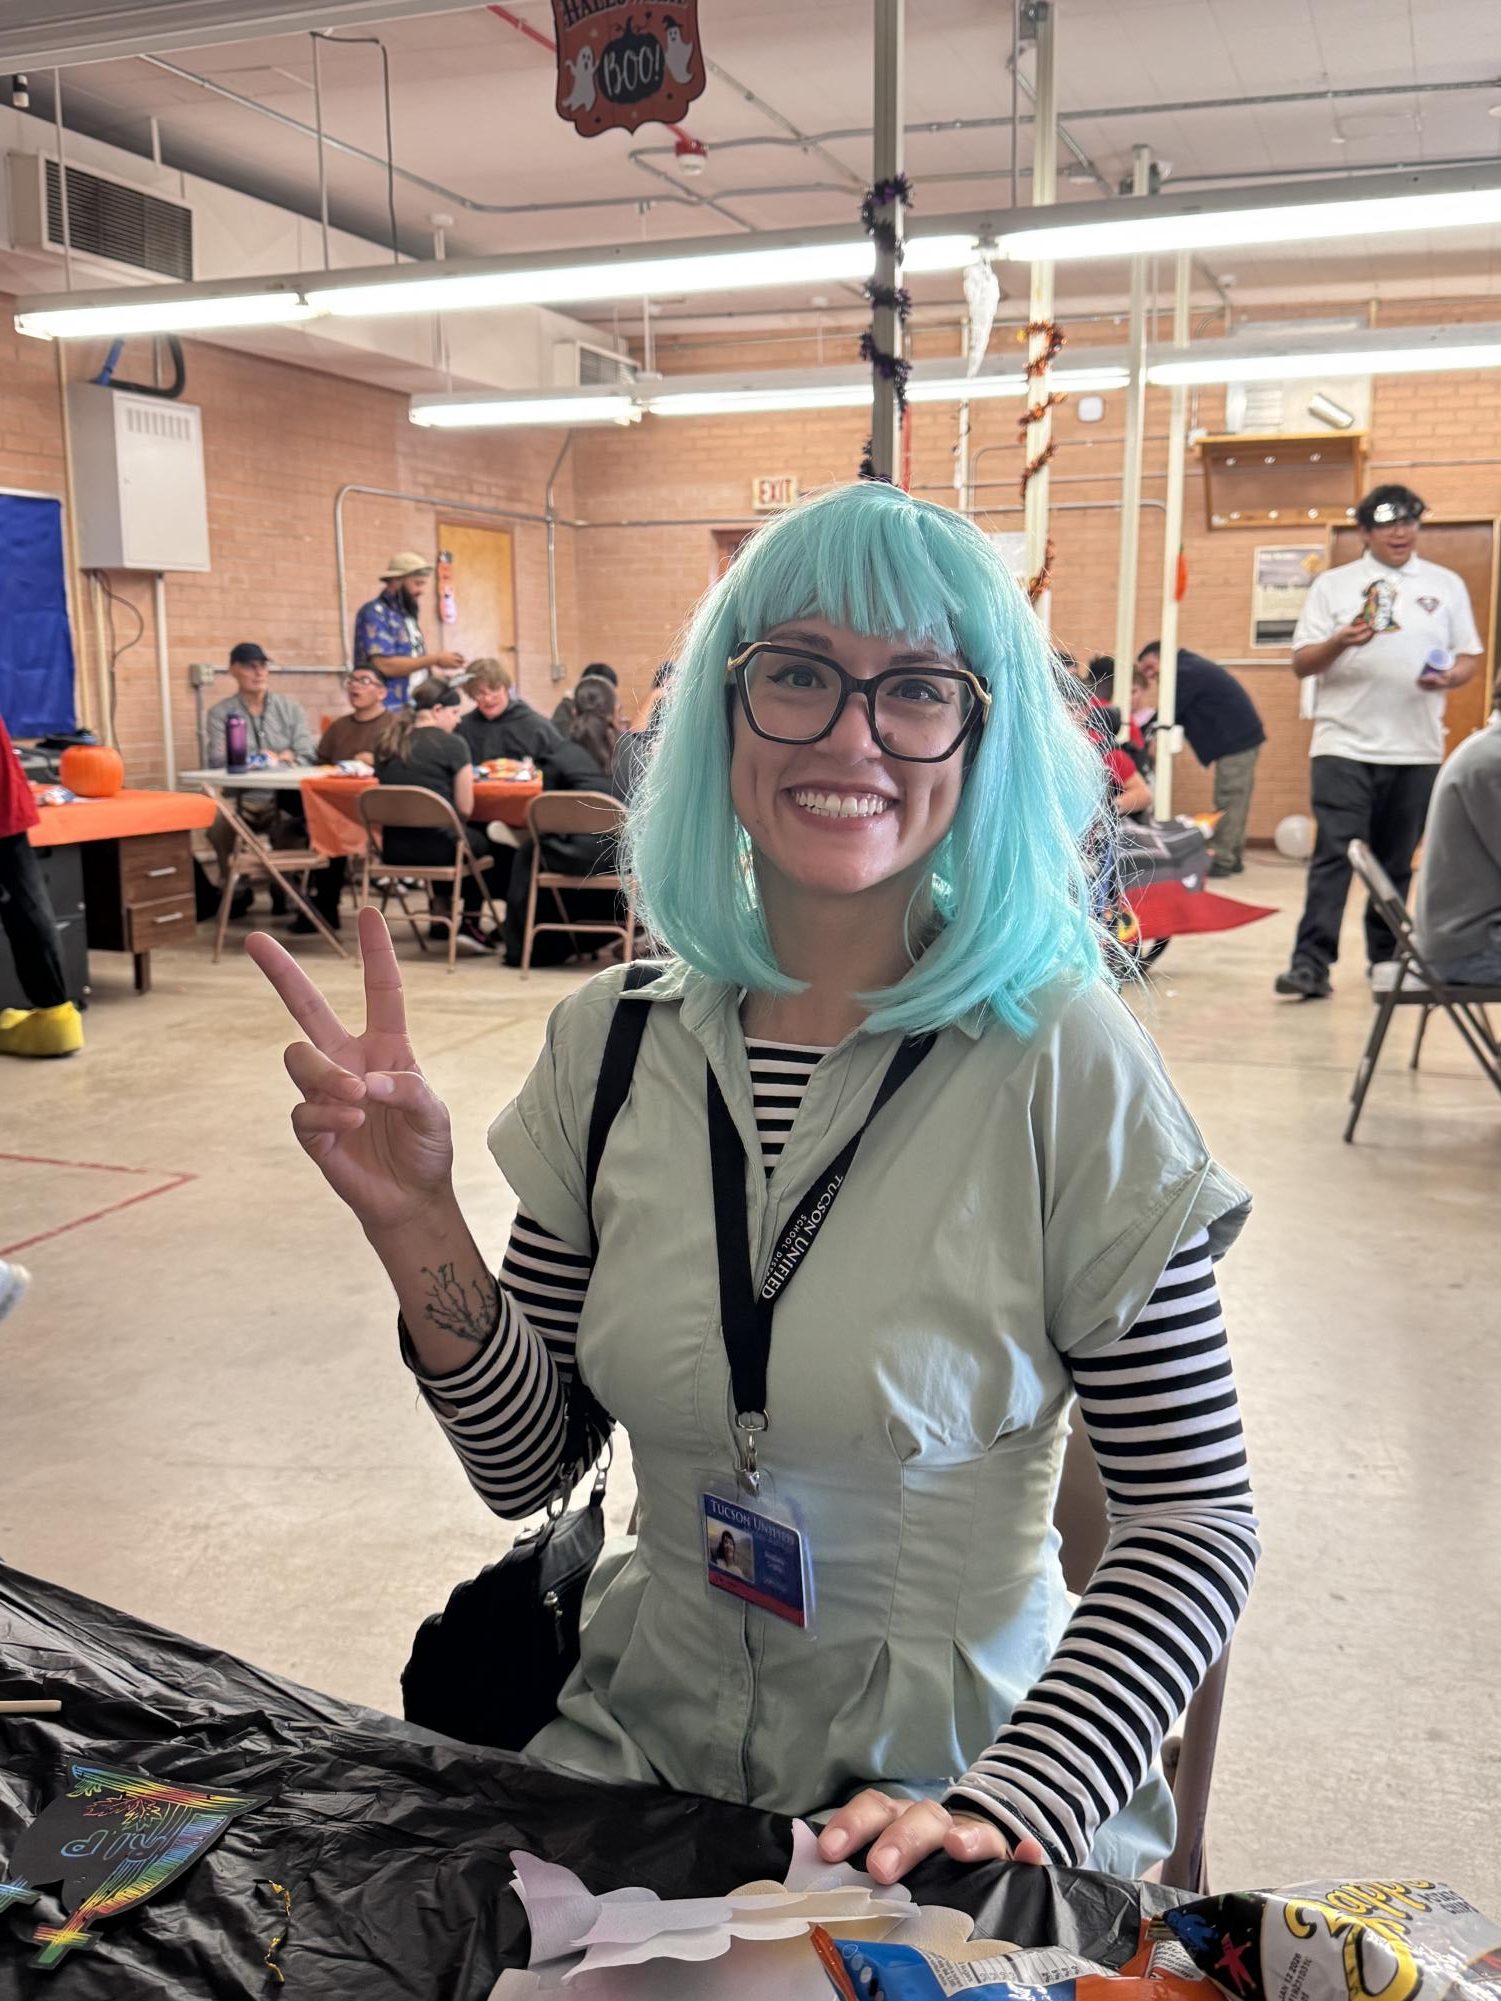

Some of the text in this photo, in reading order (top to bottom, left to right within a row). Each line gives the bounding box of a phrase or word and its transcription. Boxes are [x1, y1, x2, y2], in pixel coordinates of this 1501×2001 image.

[603, 44, 661, 96] BOO!
[759, 479, 791, 504] EXIT
[761, 1175, 843, 1299] TUCSON UNIFIED
[782, 1214, 807, 1249] SCHOOL
